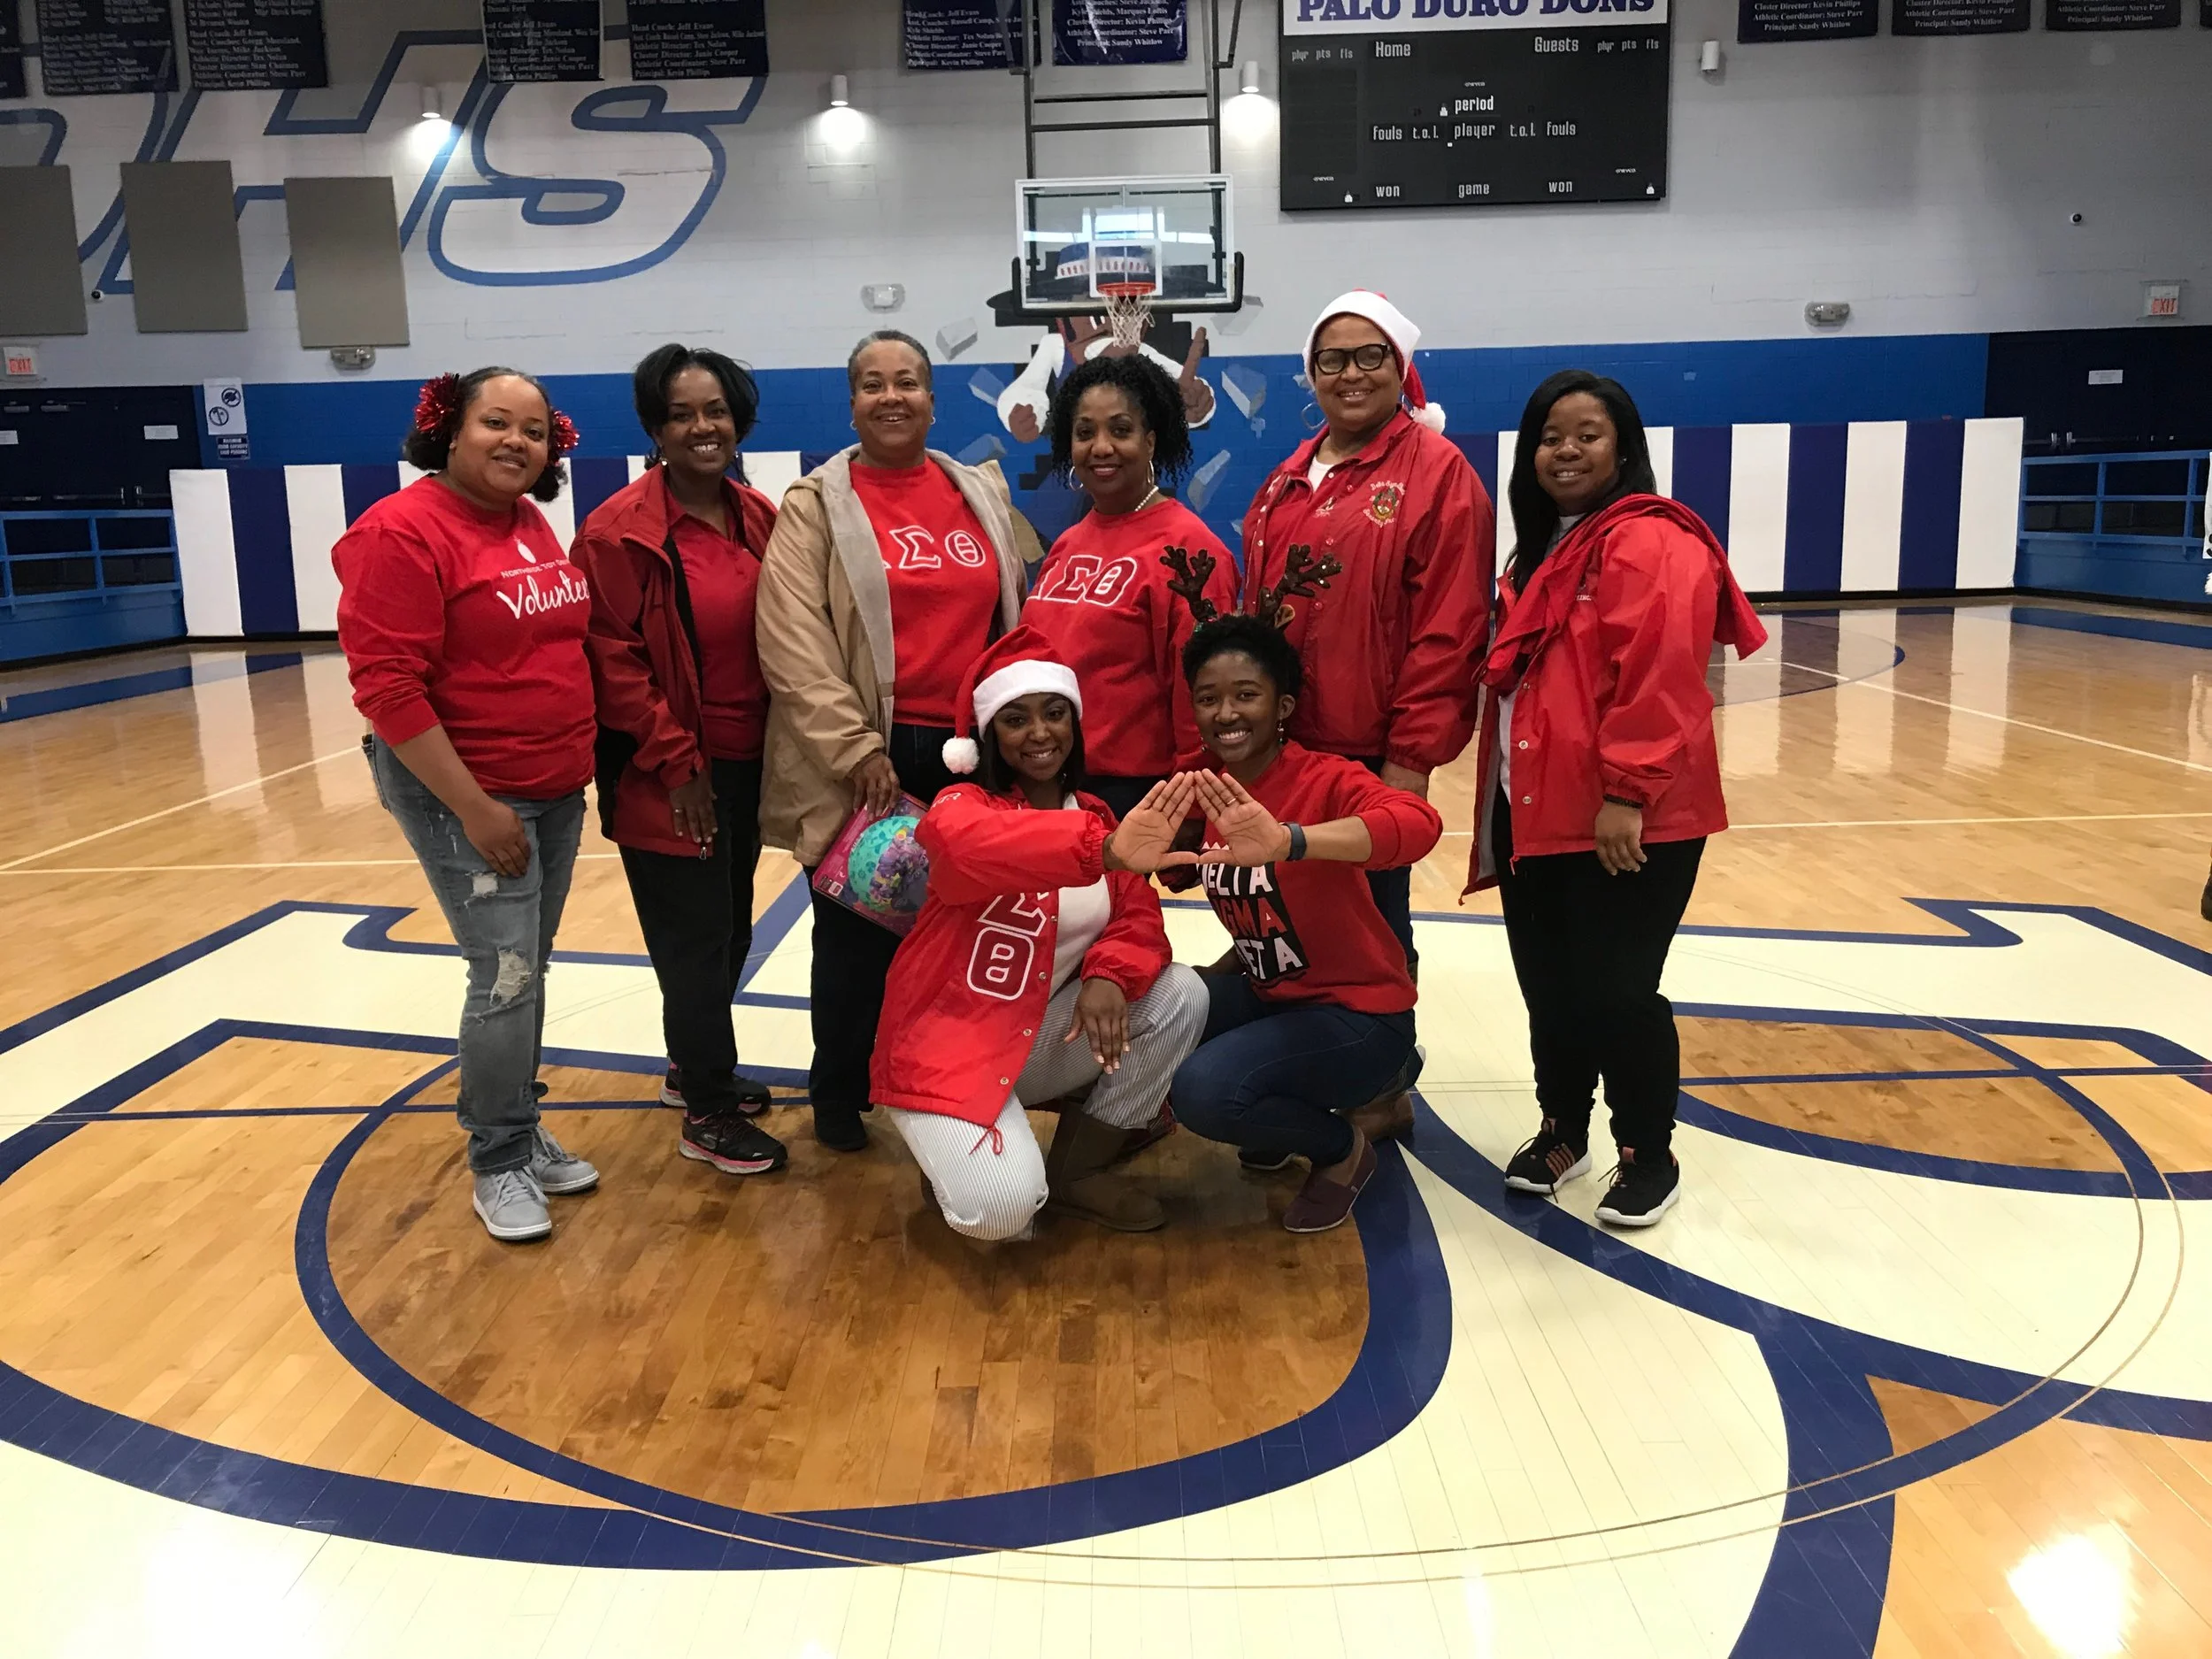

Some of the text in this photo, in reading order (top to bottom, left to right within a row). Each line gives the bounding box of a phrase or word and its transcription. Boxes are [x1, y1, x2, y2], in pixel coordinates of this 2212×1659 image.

[1297, 0, 1655, 21] PALO DURO DONS
[1374, 41, 1411, 58] Home
[1533, 35, 1579, 53] Guests
[1621, 40, 1637, 52] pts
[1646, 38, 1659, 50] fls
[1315, 49, 1331, 60] pts
[1454, 95, 1494, 115] period
[1372, 125, 1403, 141] fouls
[1454, 122, 1496, 140] player
[1546, 120, 1578, 137] fouls
[1375, 185, 1401, 198] won
[1458, 183, 1491, 199] game
[1548, 180, 1574, 194] won
[2152, 298, 2177, 314] EXIT
[883, 525, 987, 569] ΣΘ
